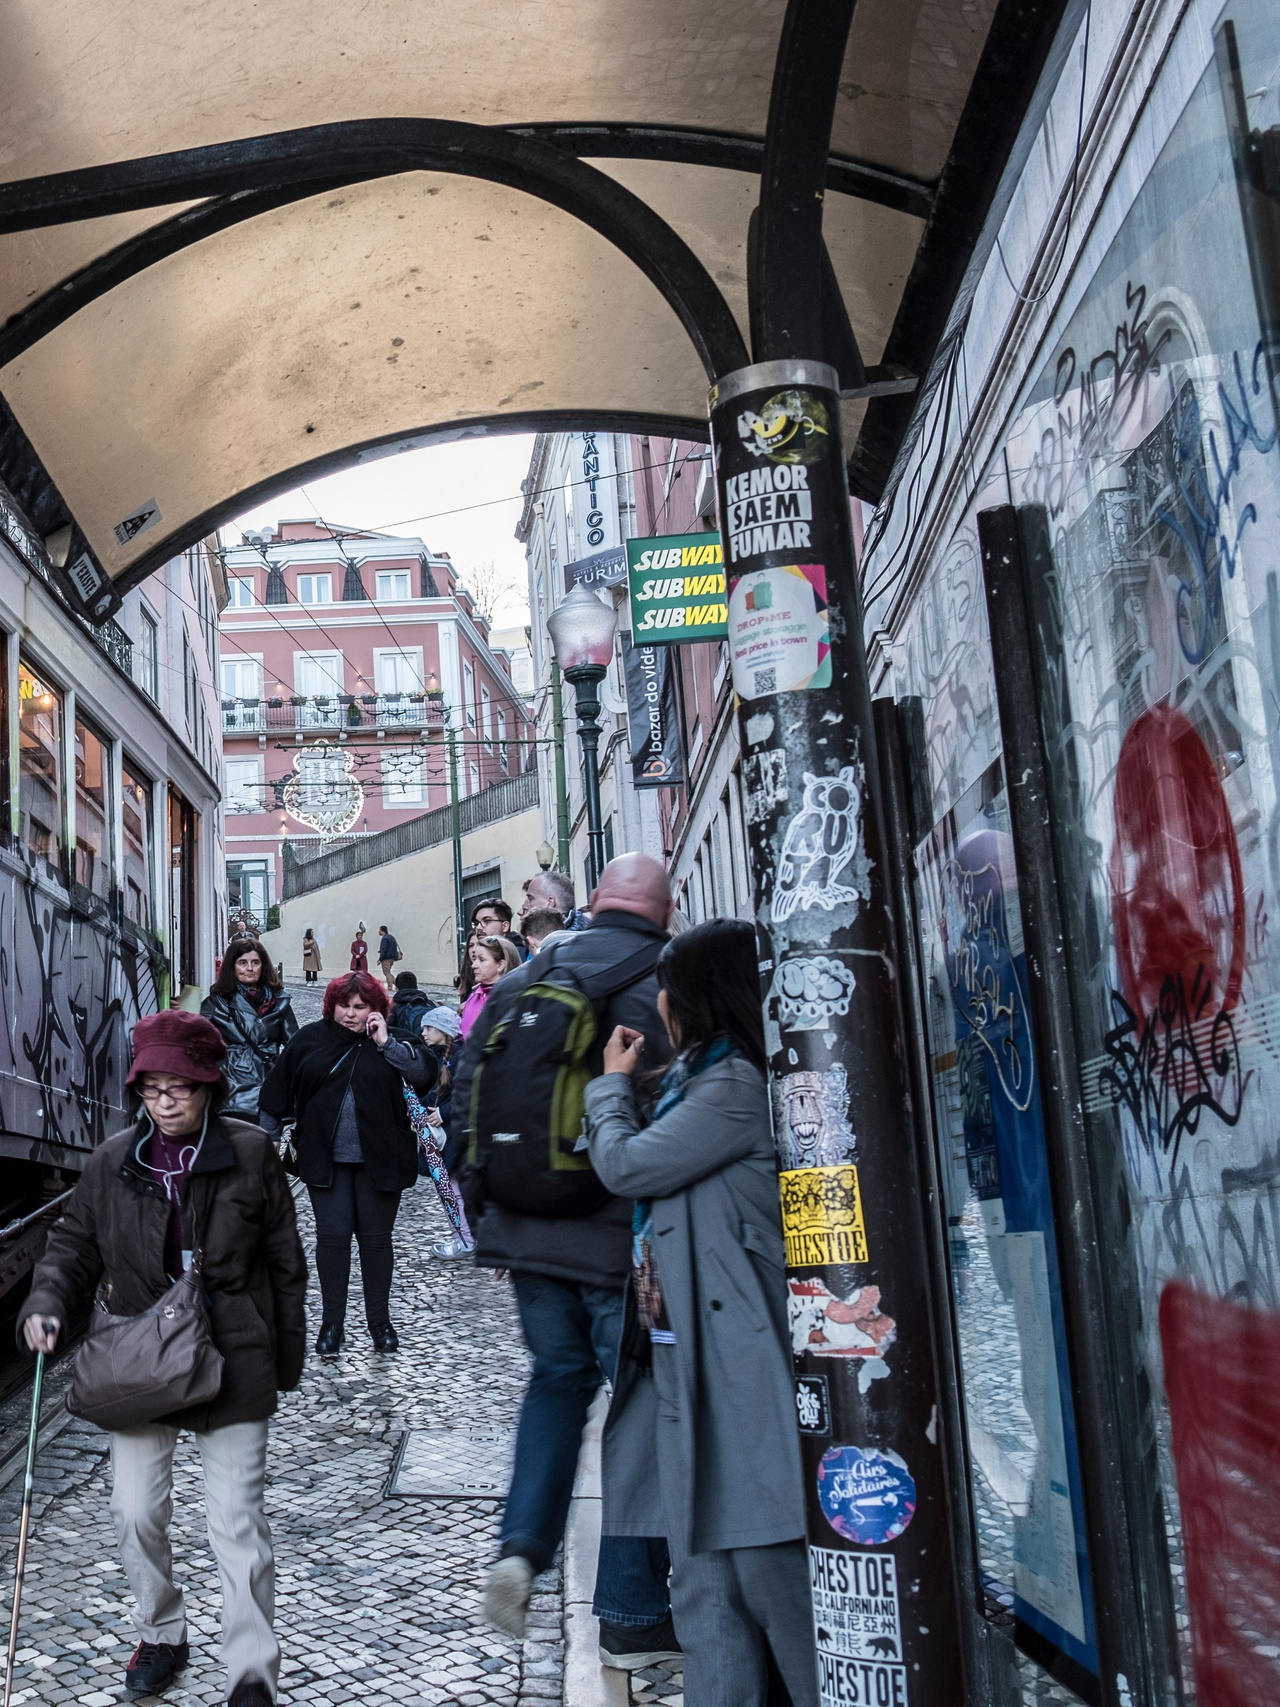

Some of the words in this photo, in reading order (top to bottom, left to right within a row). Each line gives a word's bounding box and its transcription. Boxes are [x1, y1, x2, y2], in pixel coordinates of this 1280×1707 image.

[726, 465, 810, 505] KEMOR
[733, 499, 800, 530] SAEM
[730, 521, 812, 562] FUMAR
[573, 561, 626, 585] TURIM
[749, 641, 768, 655] price
[770, 638, 778, 646] in
[781, 636, 807, 645] town
[640, 646, 656, 679] víde
[644, 682, 658, 703] do
[649, 706, 662, 752] bazar
[829, 1475, 900, 1509] Solidaires
[825, 1593, 896, 1616] CALIFORNIANO
